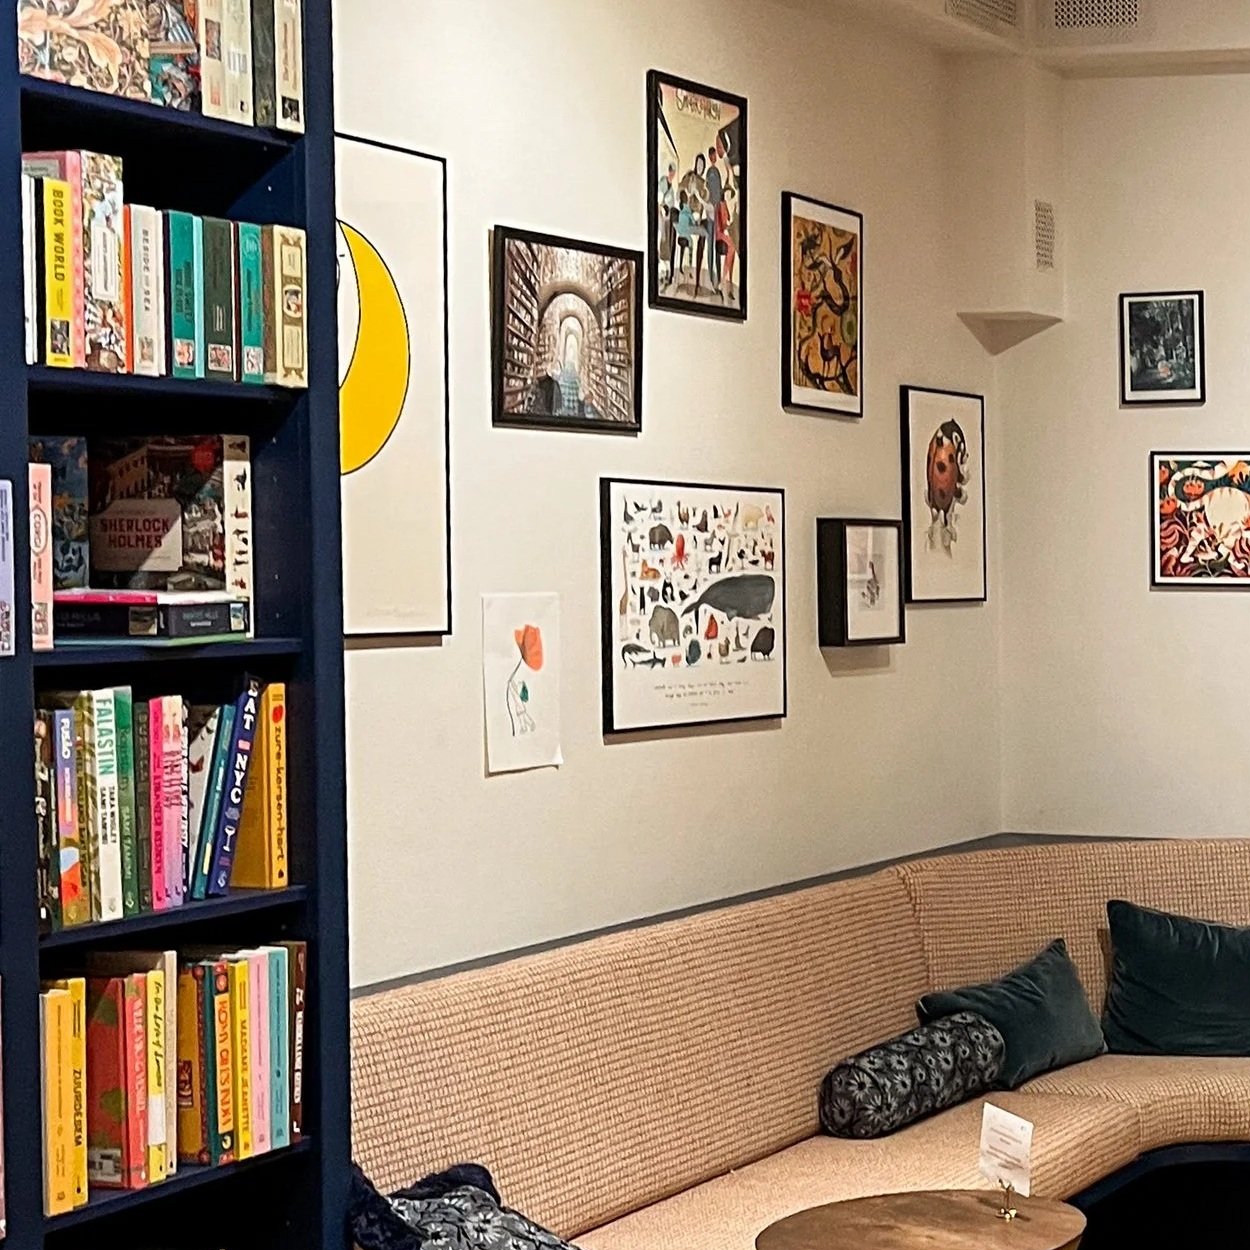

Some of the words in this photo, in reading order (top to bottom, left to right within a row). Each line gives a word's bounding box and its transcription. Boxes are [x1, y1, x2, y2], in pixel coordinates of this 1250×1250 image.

[52, 189, 65, 227] BOOK
[53, 232, 65, 281] WORLD
[100, 518, 171, 533] SHERLOCK
[108, 534, 163, 548] HOLMES
[96, 698, 115, 776] FALASTIN
[230, 752, 248, 804] NYC
[73, 1069, 82, 1147] ZUURDESEM
